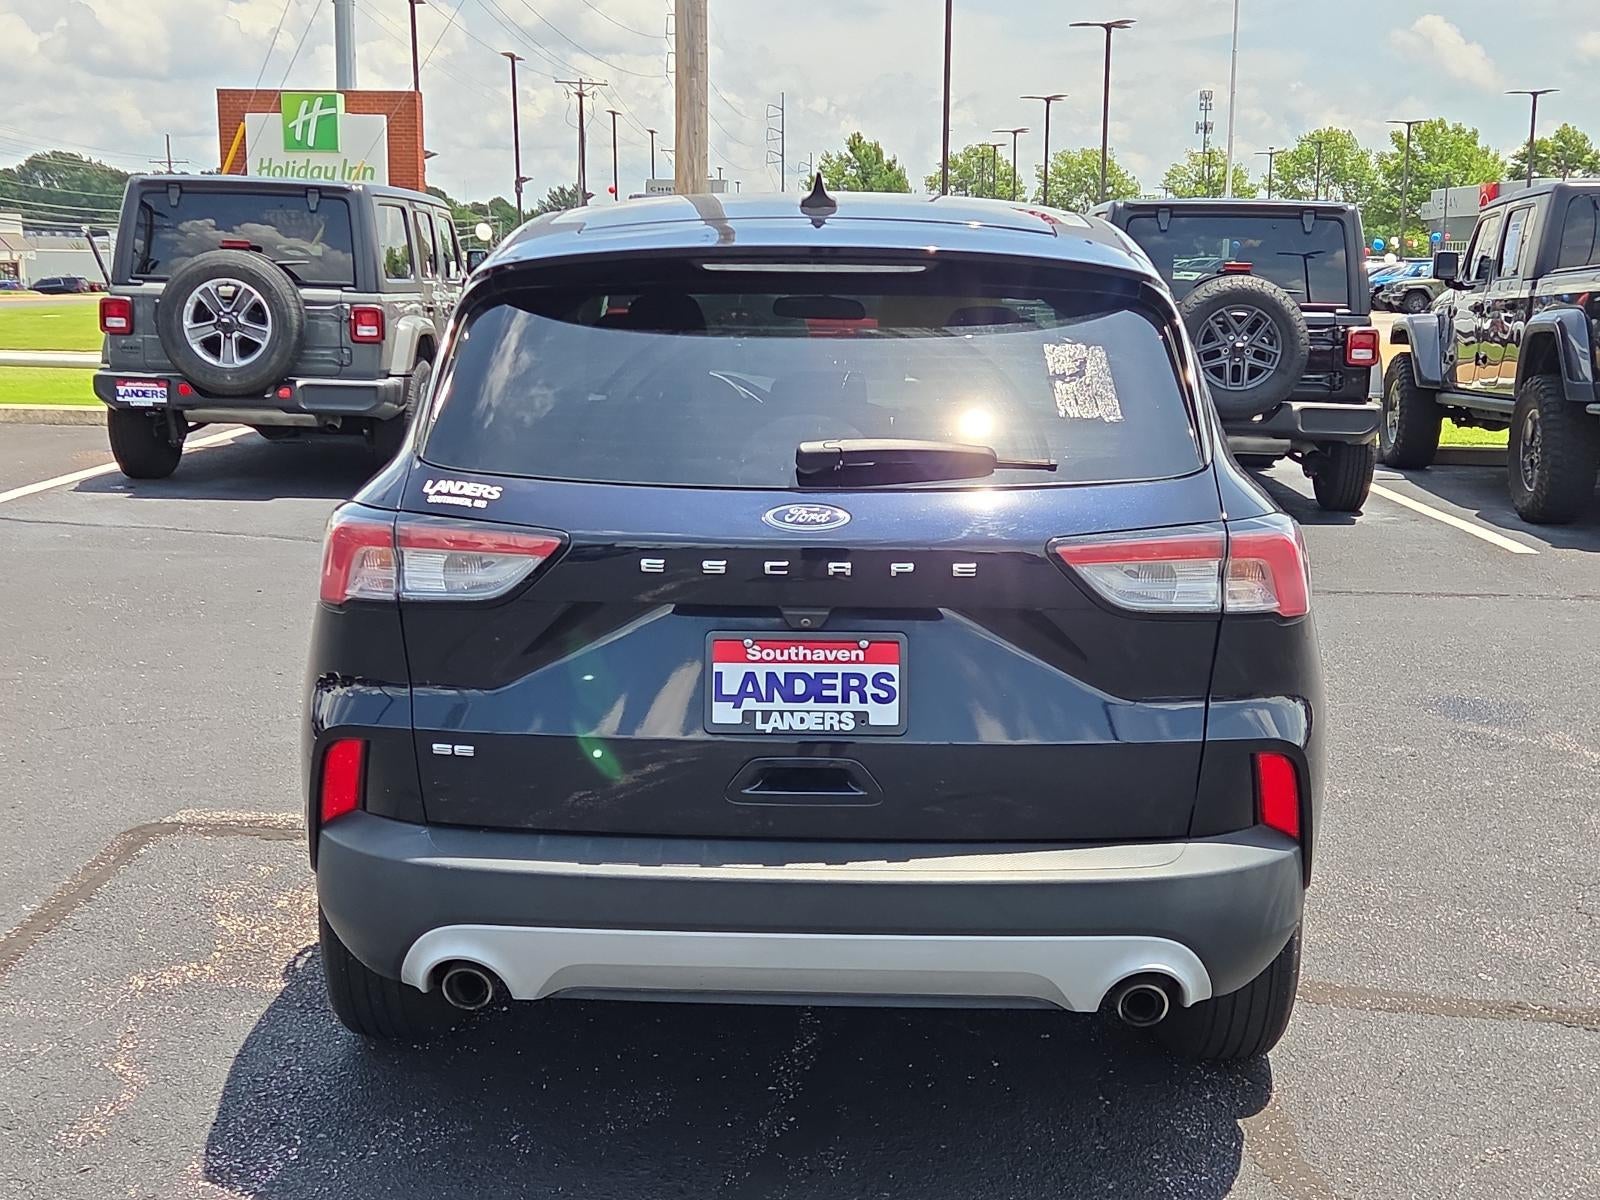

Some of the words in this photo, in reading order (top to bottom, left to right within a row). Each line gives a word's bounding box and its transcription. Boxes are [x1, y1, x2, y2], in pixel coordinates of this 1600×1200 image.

[257, 158, 336, 180] Holiday
[341, 158, 375, 181] Inn
[117, 389, 166, 399] LANDERS
[422, 479, 503, 500] LANDERS
[784, 506, 832, 523] Ford
[640, 557, 977, 577] ESCAPE
[746, 645, 865, 662] Southaven
[714, 671, 897, 709] LANDERS
[755, 711, 856, 733] LANDERS
[432, 743, 475, 757] SE
